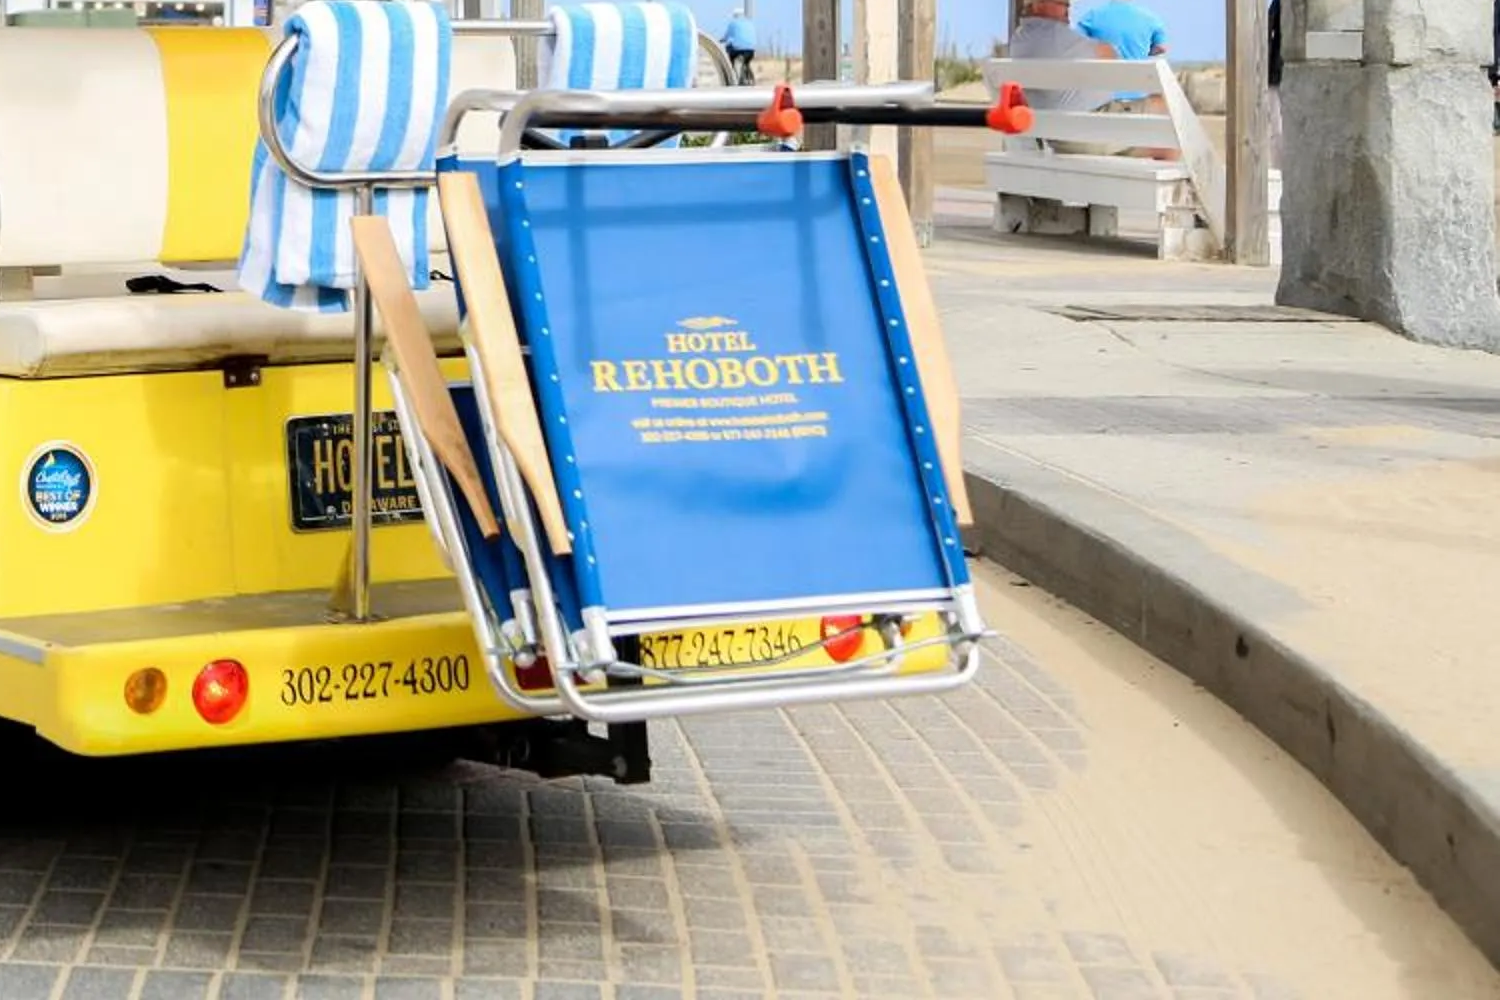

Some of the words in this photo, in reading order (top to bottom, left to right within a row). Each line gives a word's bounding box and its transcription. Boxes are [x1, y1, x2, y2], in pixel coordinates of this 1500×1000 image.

[664, 331, 757, 354] HOTEL
[590, 352, 845, 393] REHOBOTH
[313, 434, 417, 494] HOEL
[341, 495, 416, 515] DAWARE
[641, 625, 801, 670] 877-247-7346
[281, 653, 470, 707] 302-227-4300
